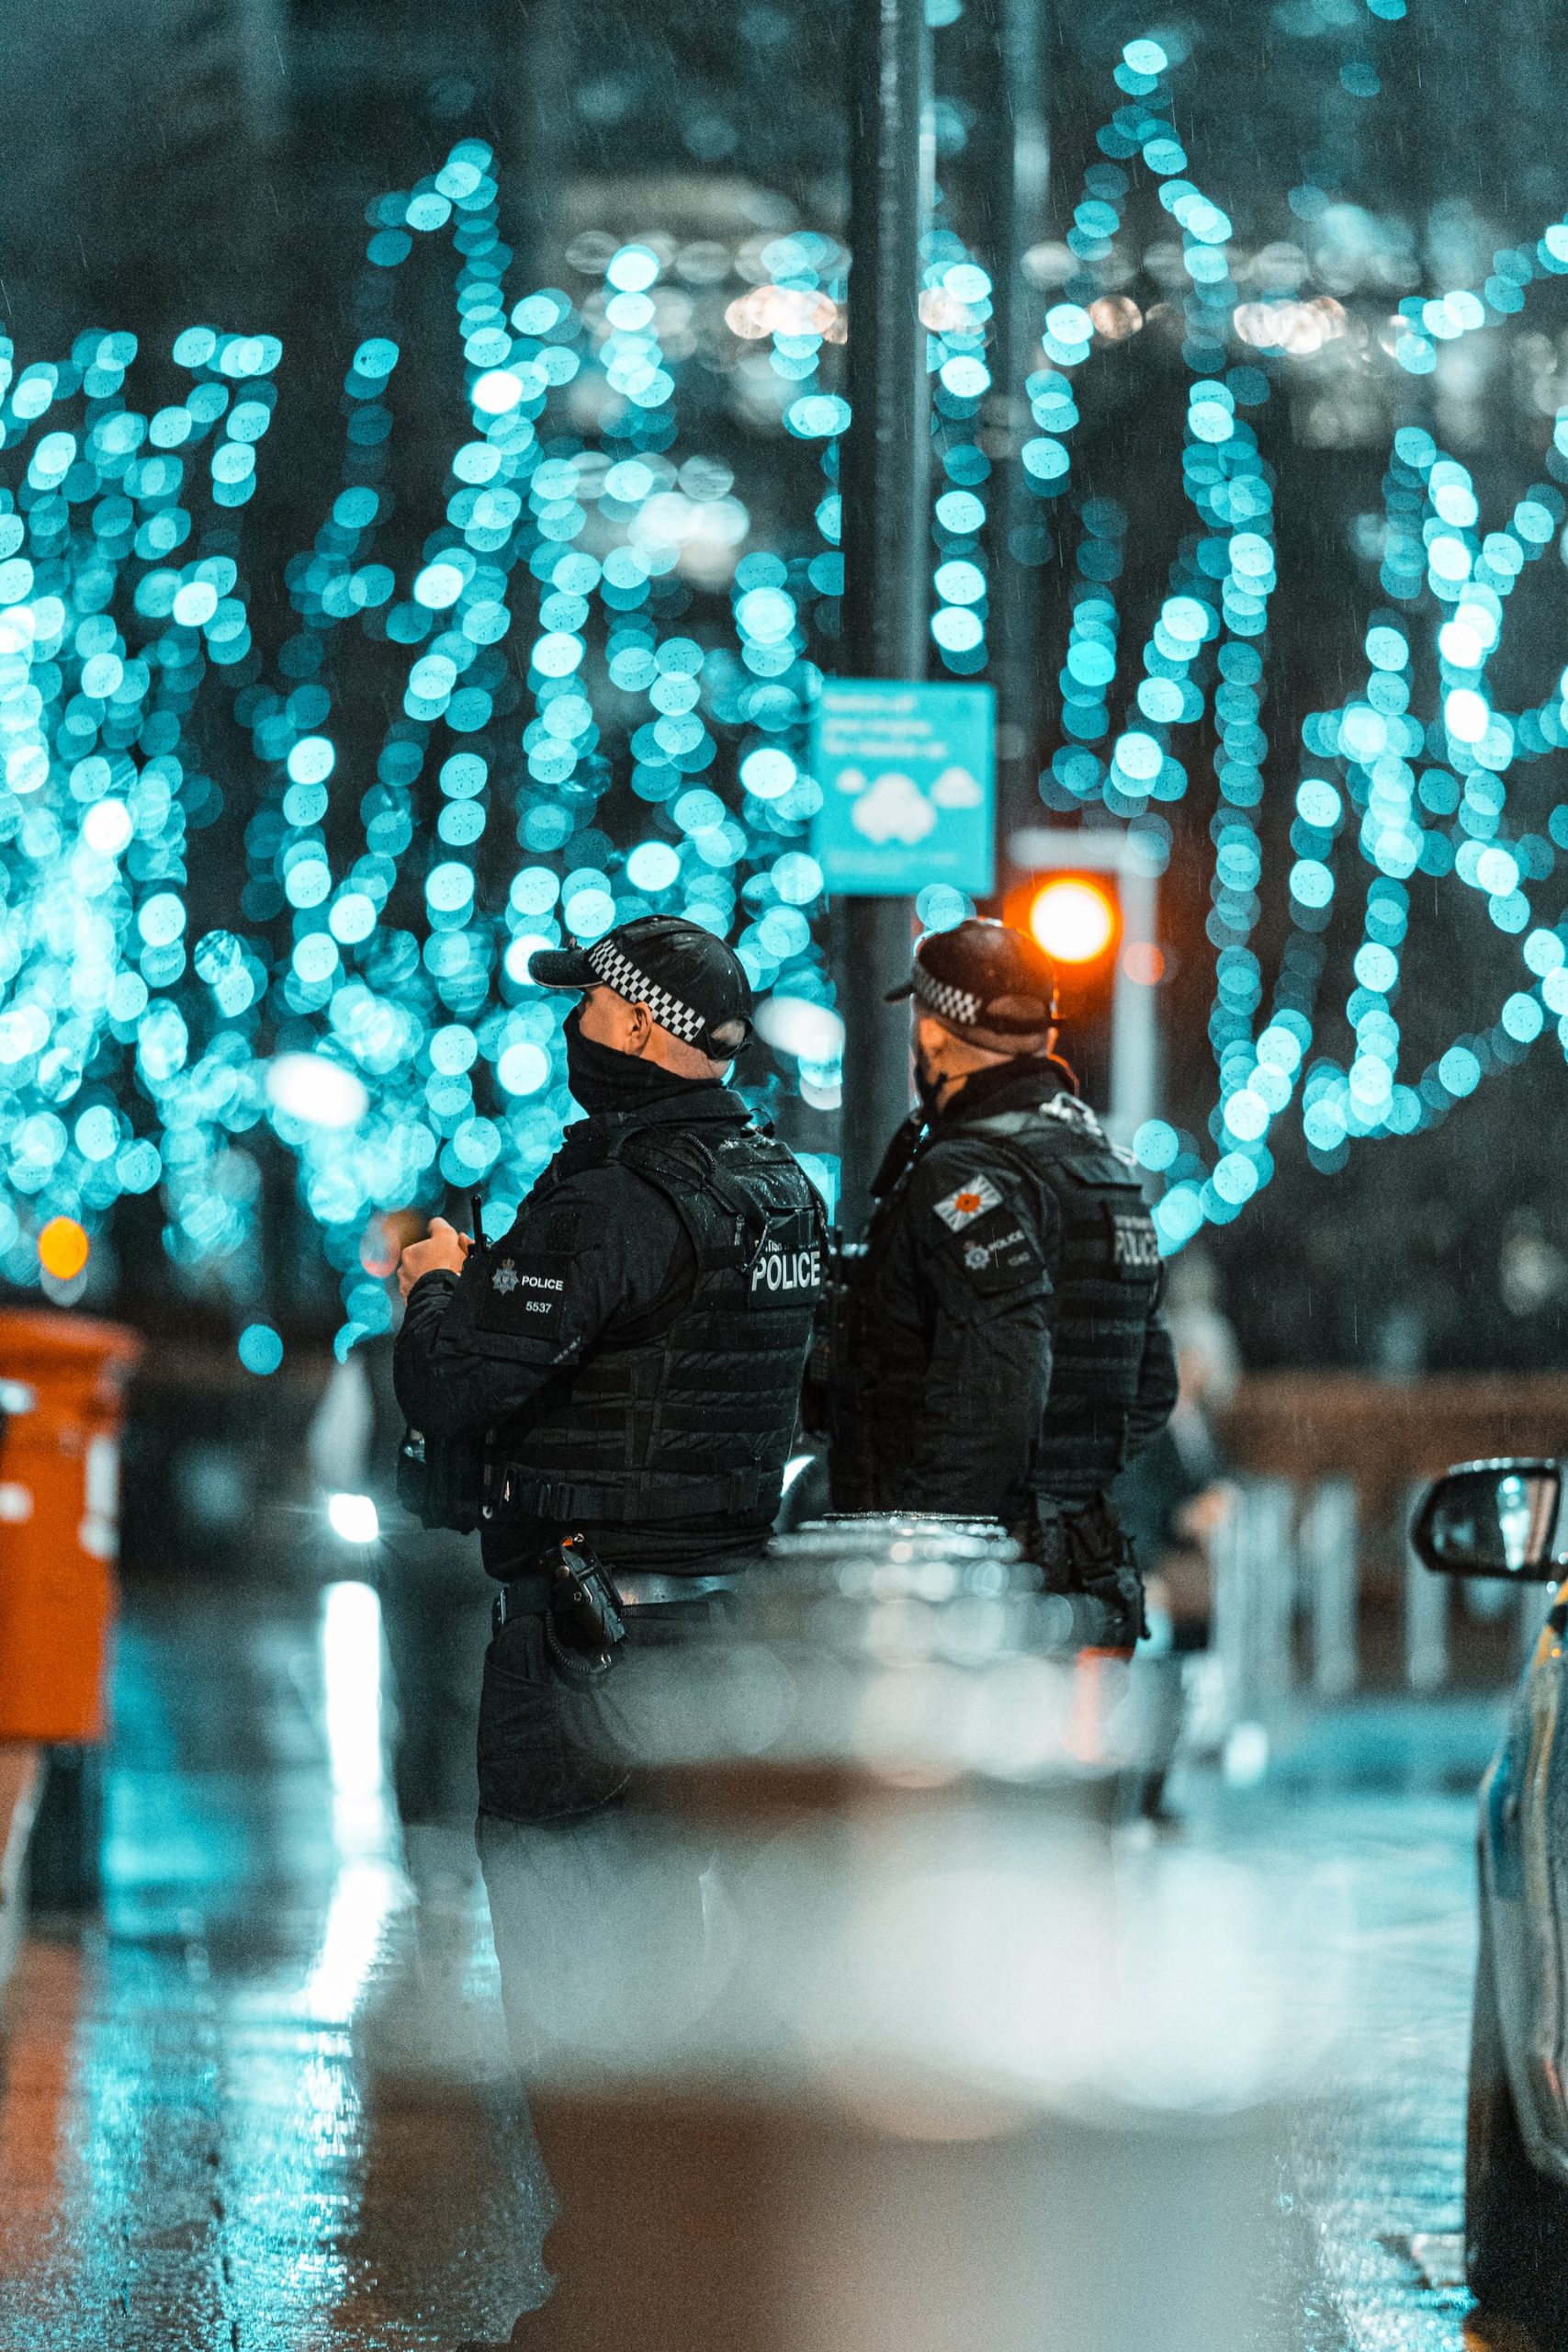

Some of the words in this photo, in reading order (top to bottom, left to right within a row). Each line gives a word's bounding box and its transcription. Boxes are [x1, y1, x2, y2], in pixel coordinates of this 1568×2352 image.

[751, 1250, 821, 1292] POLICE
[521, 1274, 564, 1292] POLICE
[525, 1301, 553, 1314] 5537
